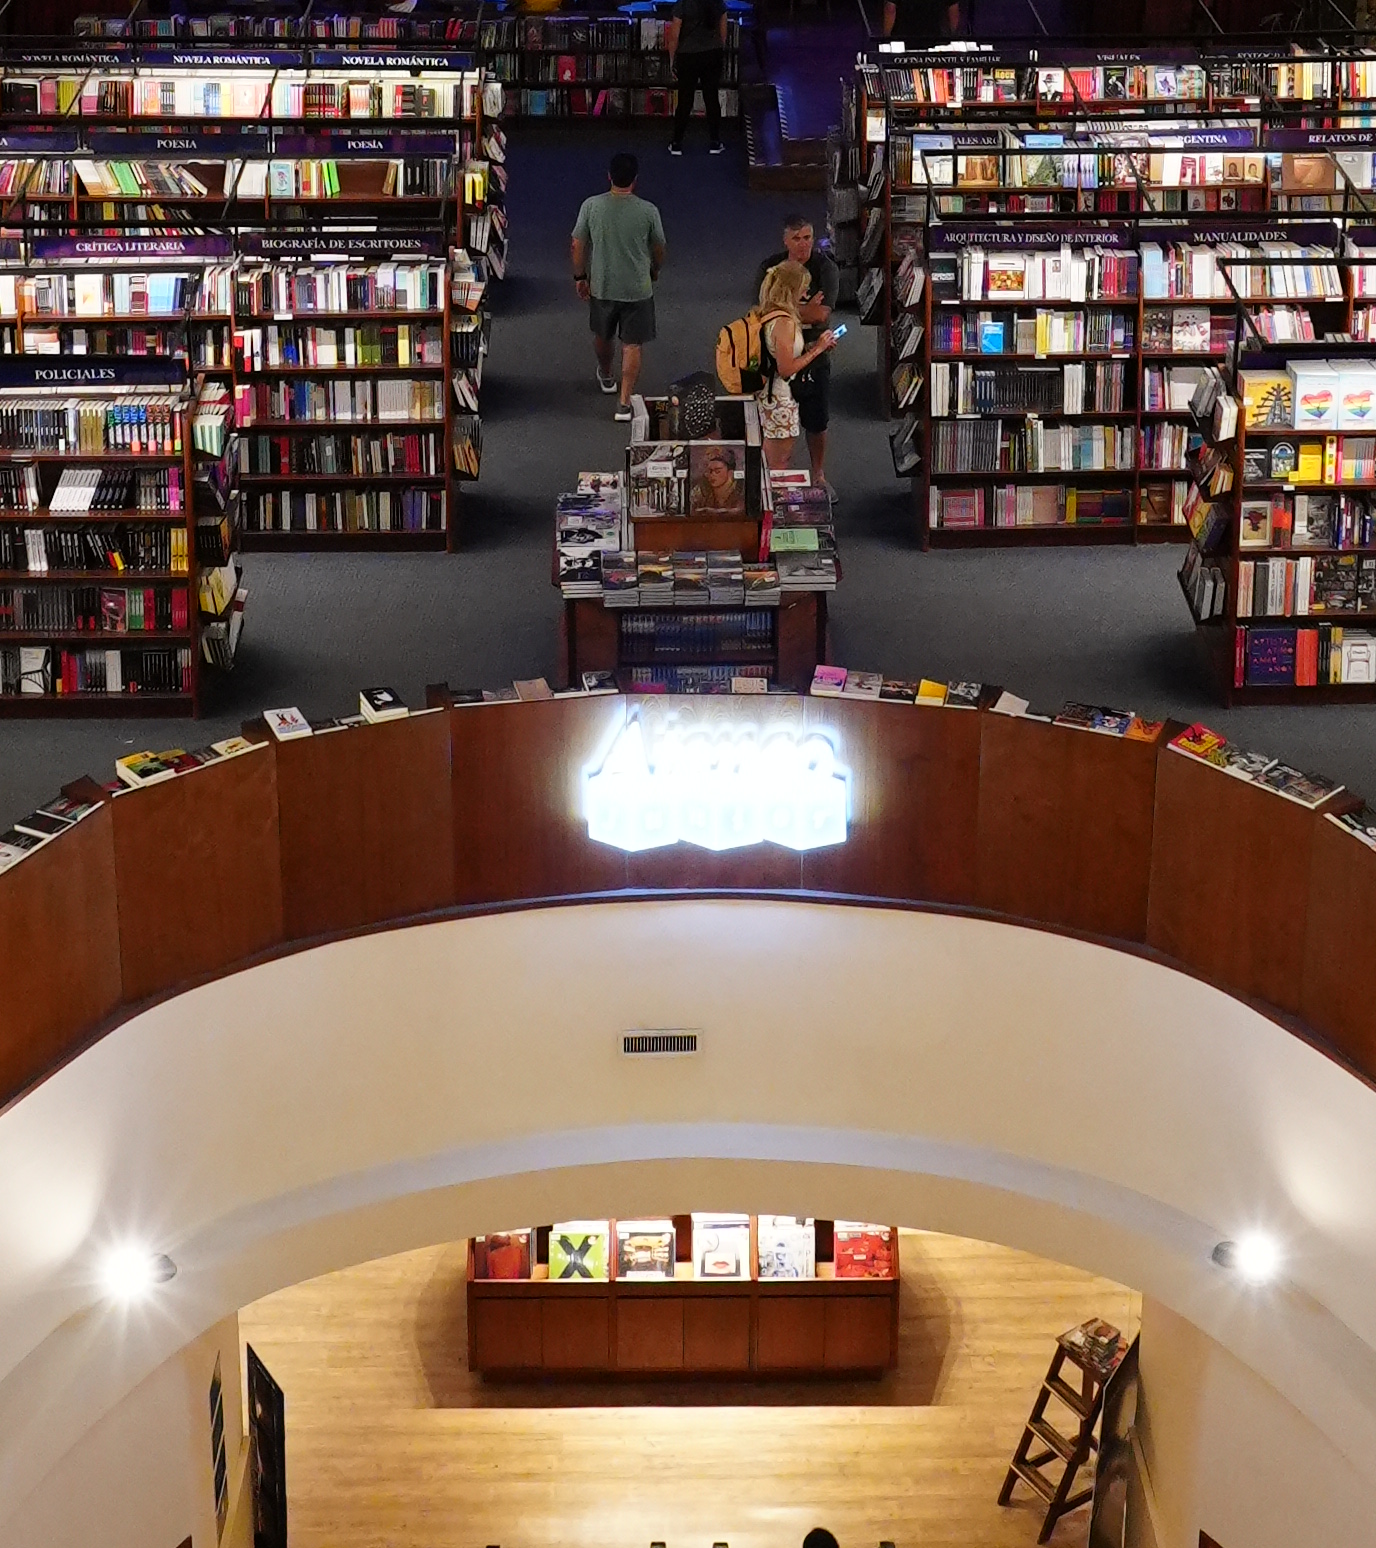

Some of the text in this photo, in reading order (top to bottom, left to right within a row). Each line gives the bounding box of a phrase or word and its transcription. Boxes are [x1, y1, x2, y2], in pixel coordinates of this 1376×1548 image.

[173, 54, 272, 66] NOVELA ROMÁNTICA
[343, 54, 449, 67] NOVELA ROMÁNTICA
[1308, 133, 1356, 144] RELATOS
[1356, 133, 1370, 143] DE
[943, 234, 1018, 244] ARQUITECTURA
[1024, 231, 1058, 243] DISEÑO
[1060, 233, 1072, 243] DE
[1074, 233, 1119, 243] INTERIOR
[1193, 230, 1288, 242] MANUALIDADES
[75, 240, 186, 252] CRÍTICA LITERARIA
[261, 237, 422, 250] BIOGRAFÍA DE ESCRITORES
[35, 367, 115, 380] POLICIALES
